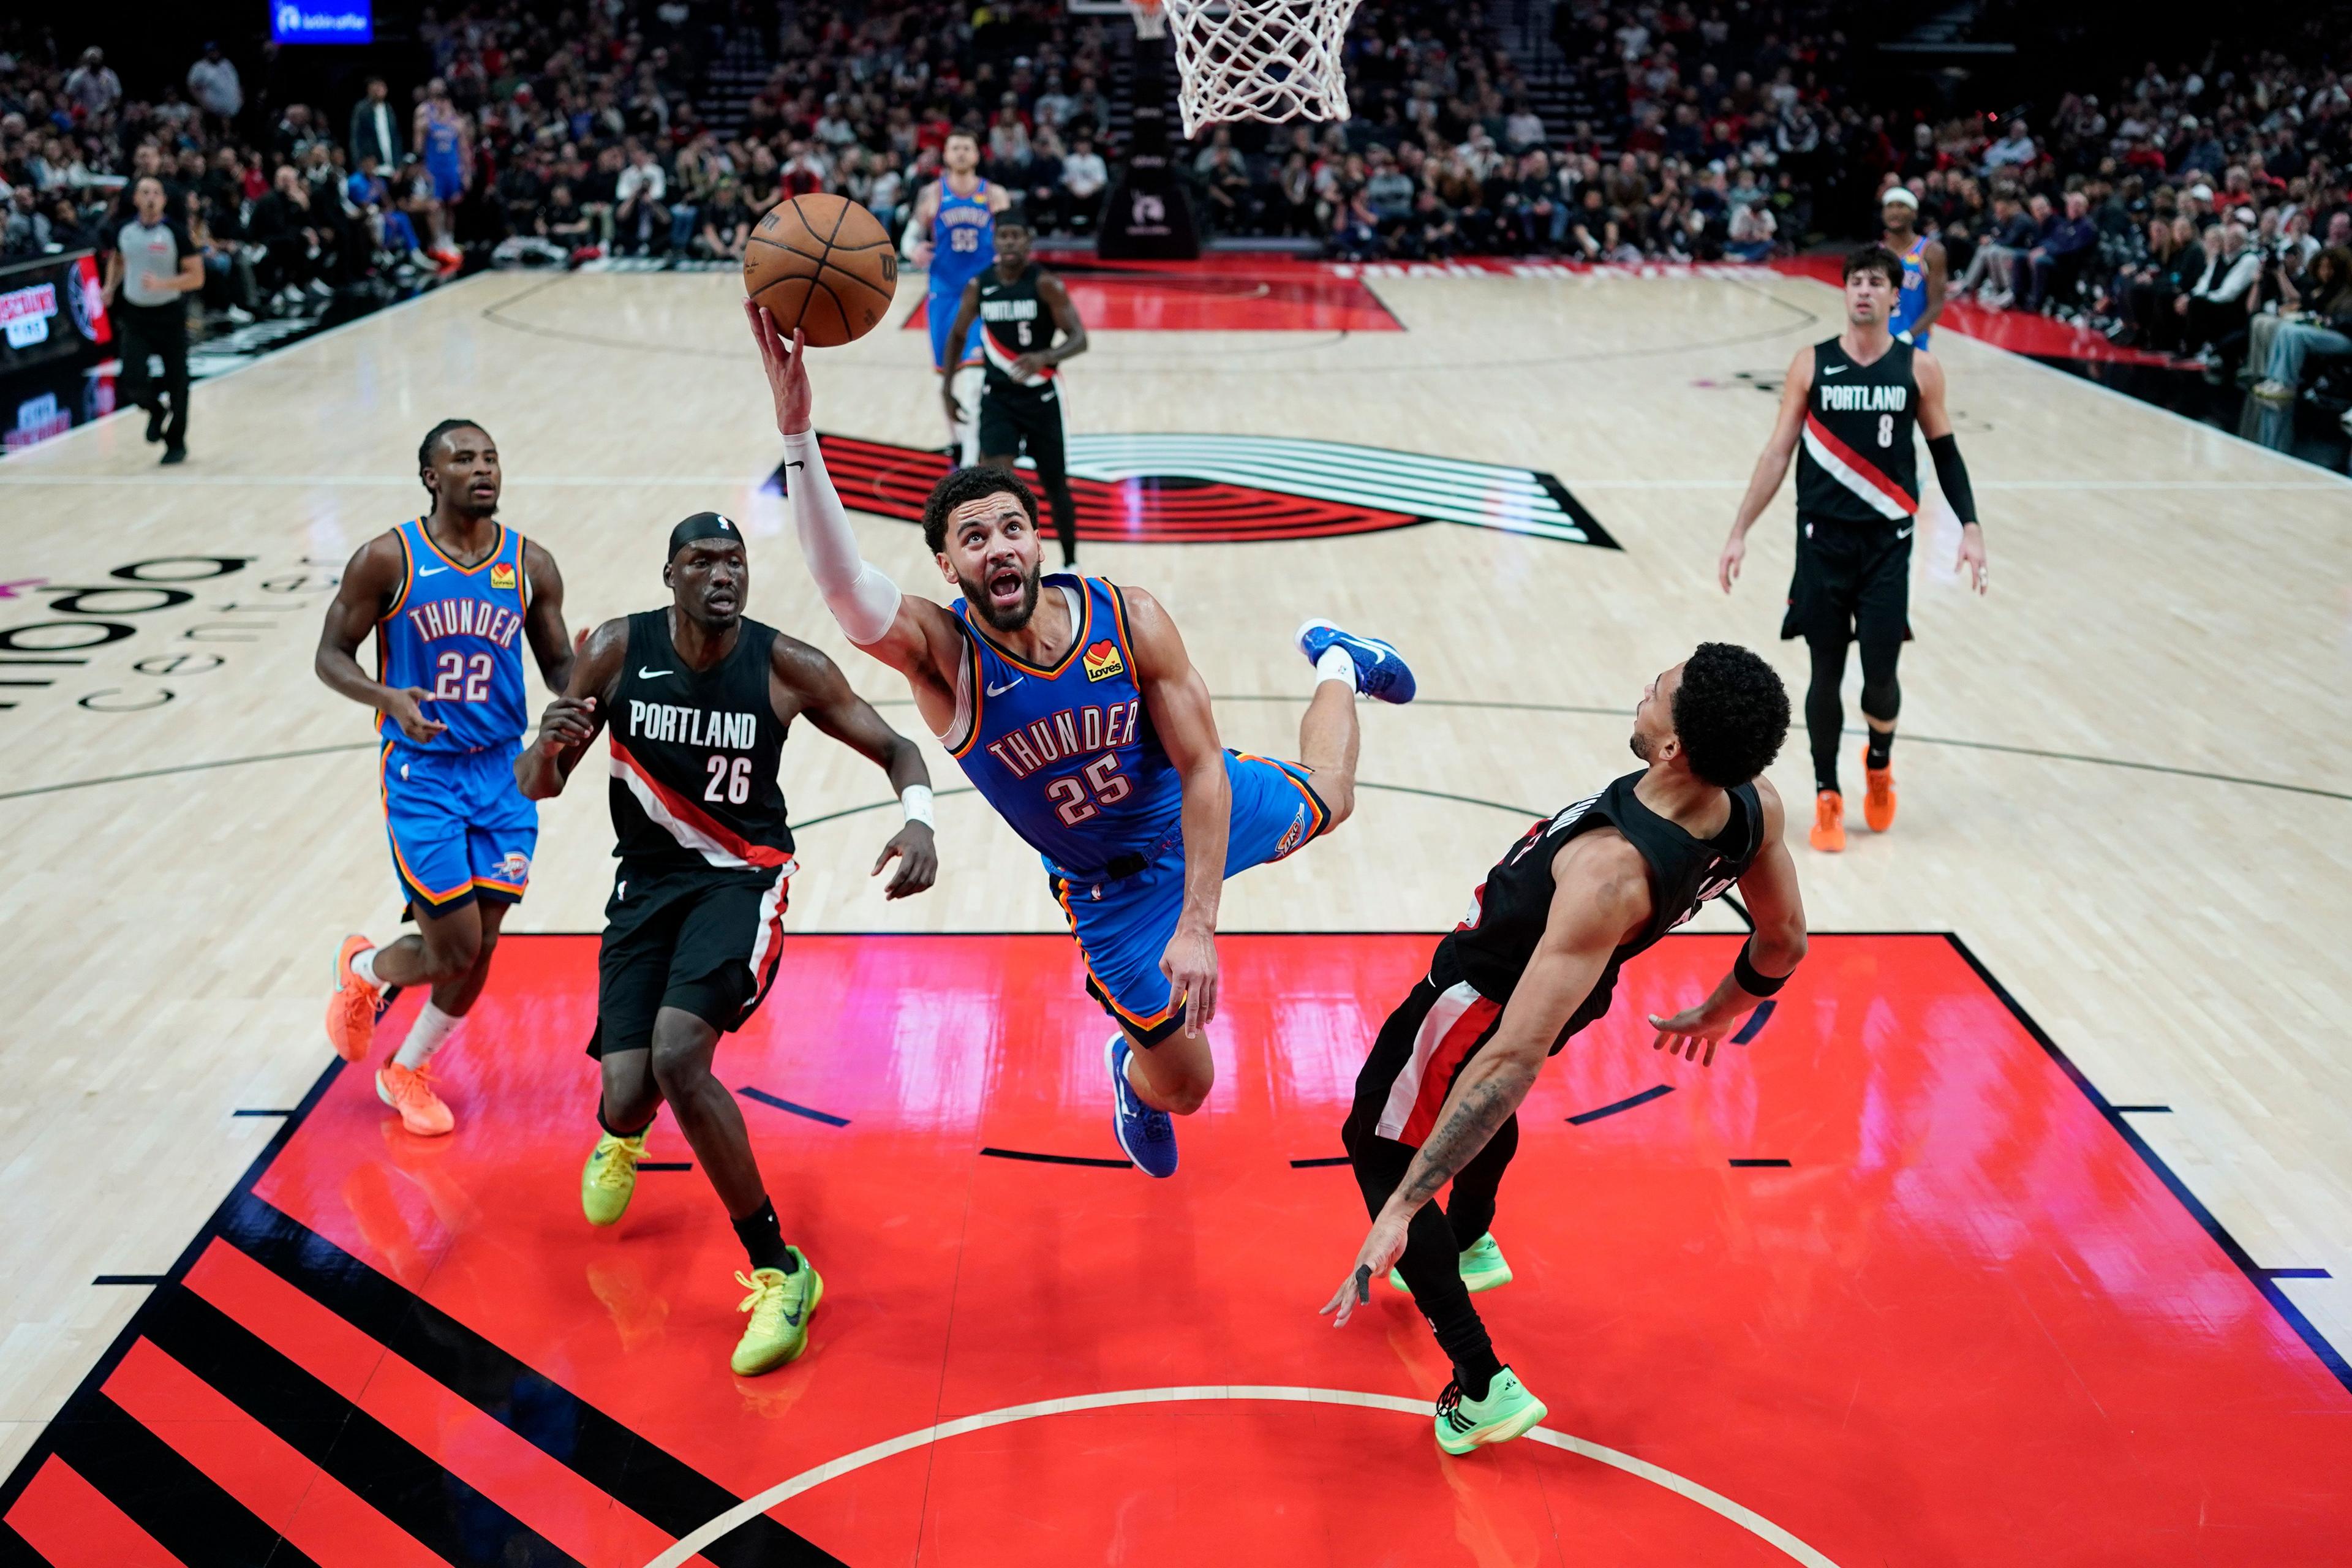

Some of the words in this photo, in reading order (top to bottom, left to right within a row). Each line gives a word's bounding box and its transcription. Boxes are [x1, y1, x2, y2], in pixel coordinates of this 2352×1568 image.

[940, 206, 992, 228] THUNDER
[951, 228, 979, 253] 55
[980, 299, 1037, 322] PORTLAND
[1018, 320, 1032, 346] 5
[1820, 385, 1907, 412] PORTLAND
[1877, 413, 1894, 448] 8
[408, 598, 524, 649] THUNDER
[435, 650, 493, 703] 22
[629, 699, 756, 750] PORTLAND
[987, 698, 1141, 780] THUNDER
[704, 755, 753, 804] 26
[1044, 750, 1133, 828] 25
